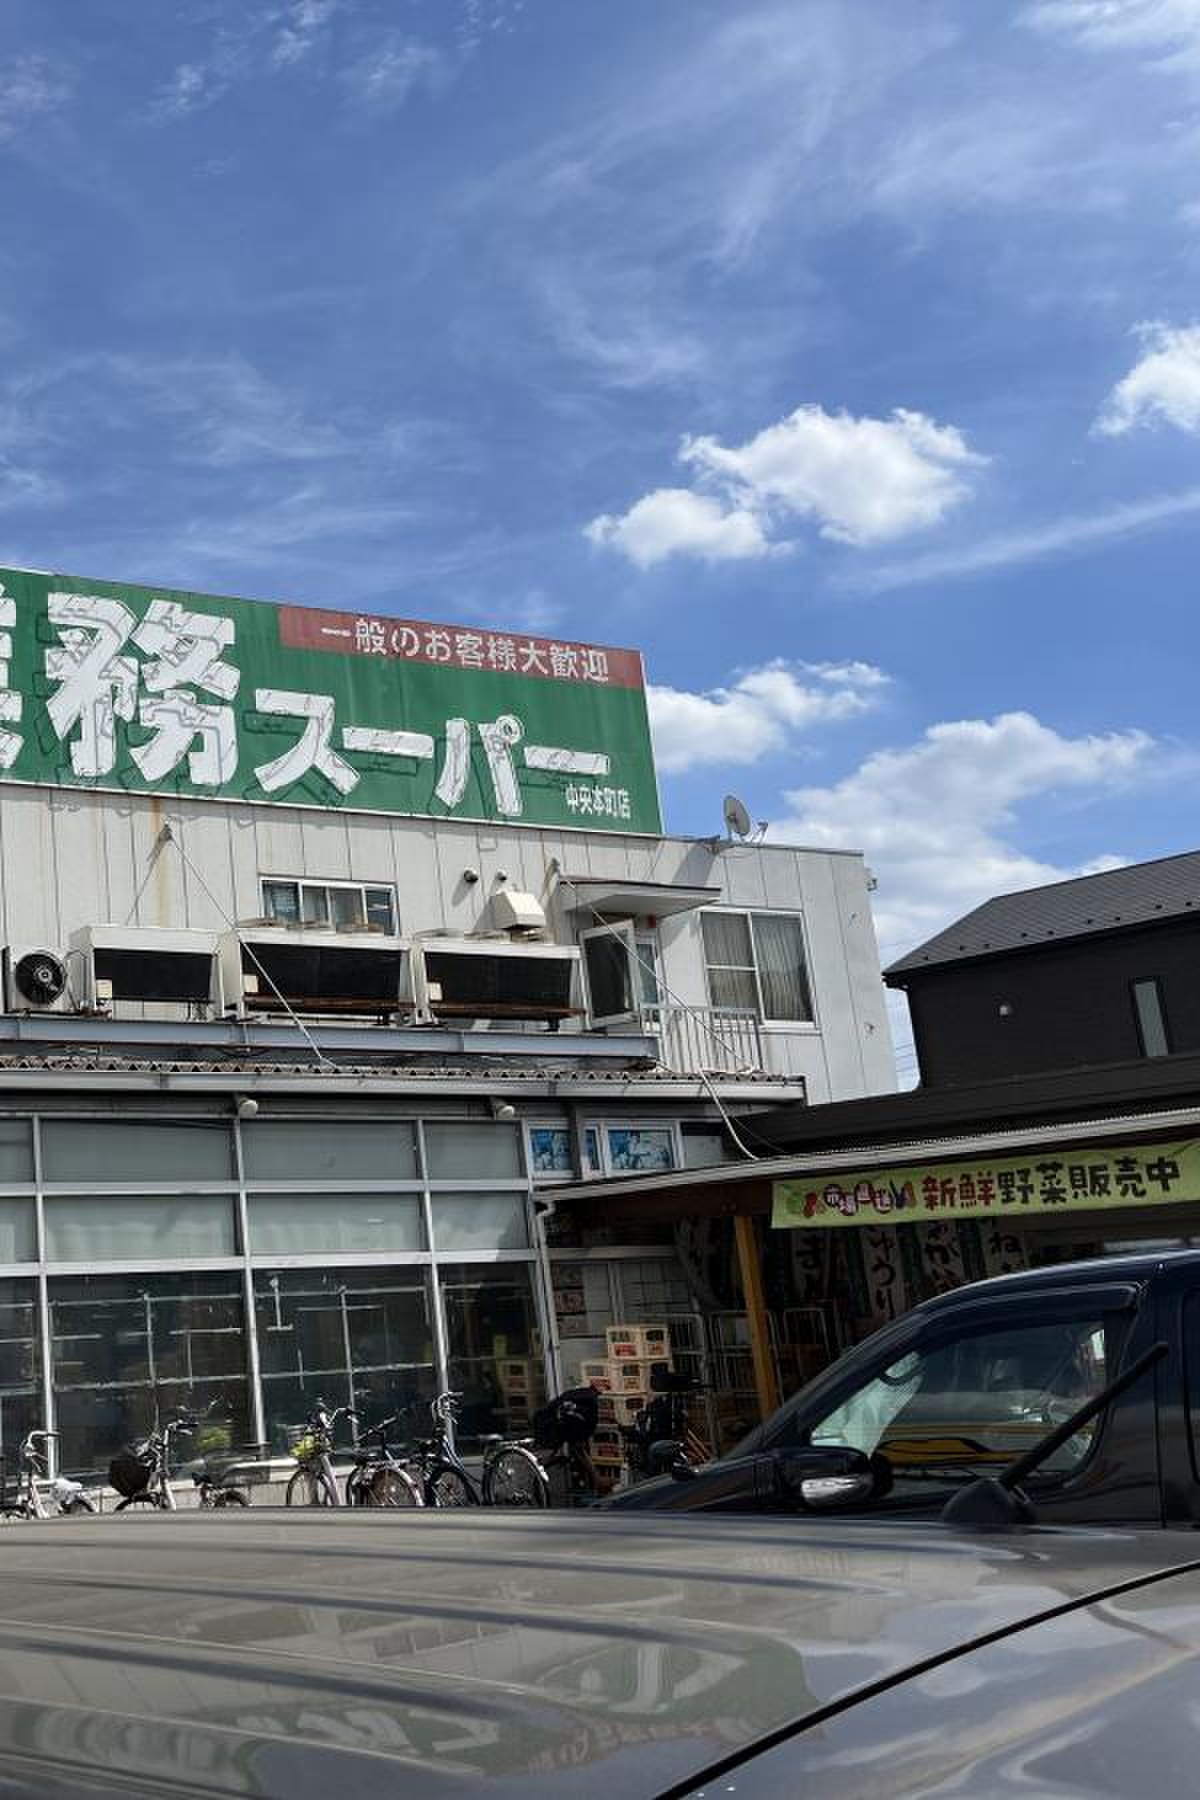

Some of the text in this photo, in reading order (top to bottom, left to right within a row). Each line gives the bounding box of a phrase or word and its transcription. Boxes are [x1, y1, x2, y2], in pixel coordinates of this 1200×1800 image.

[321, 618, 609, 682] 一般のお客様大歓迎
[921, 1156, 1181, 1209] 新鮮野菜販売中
